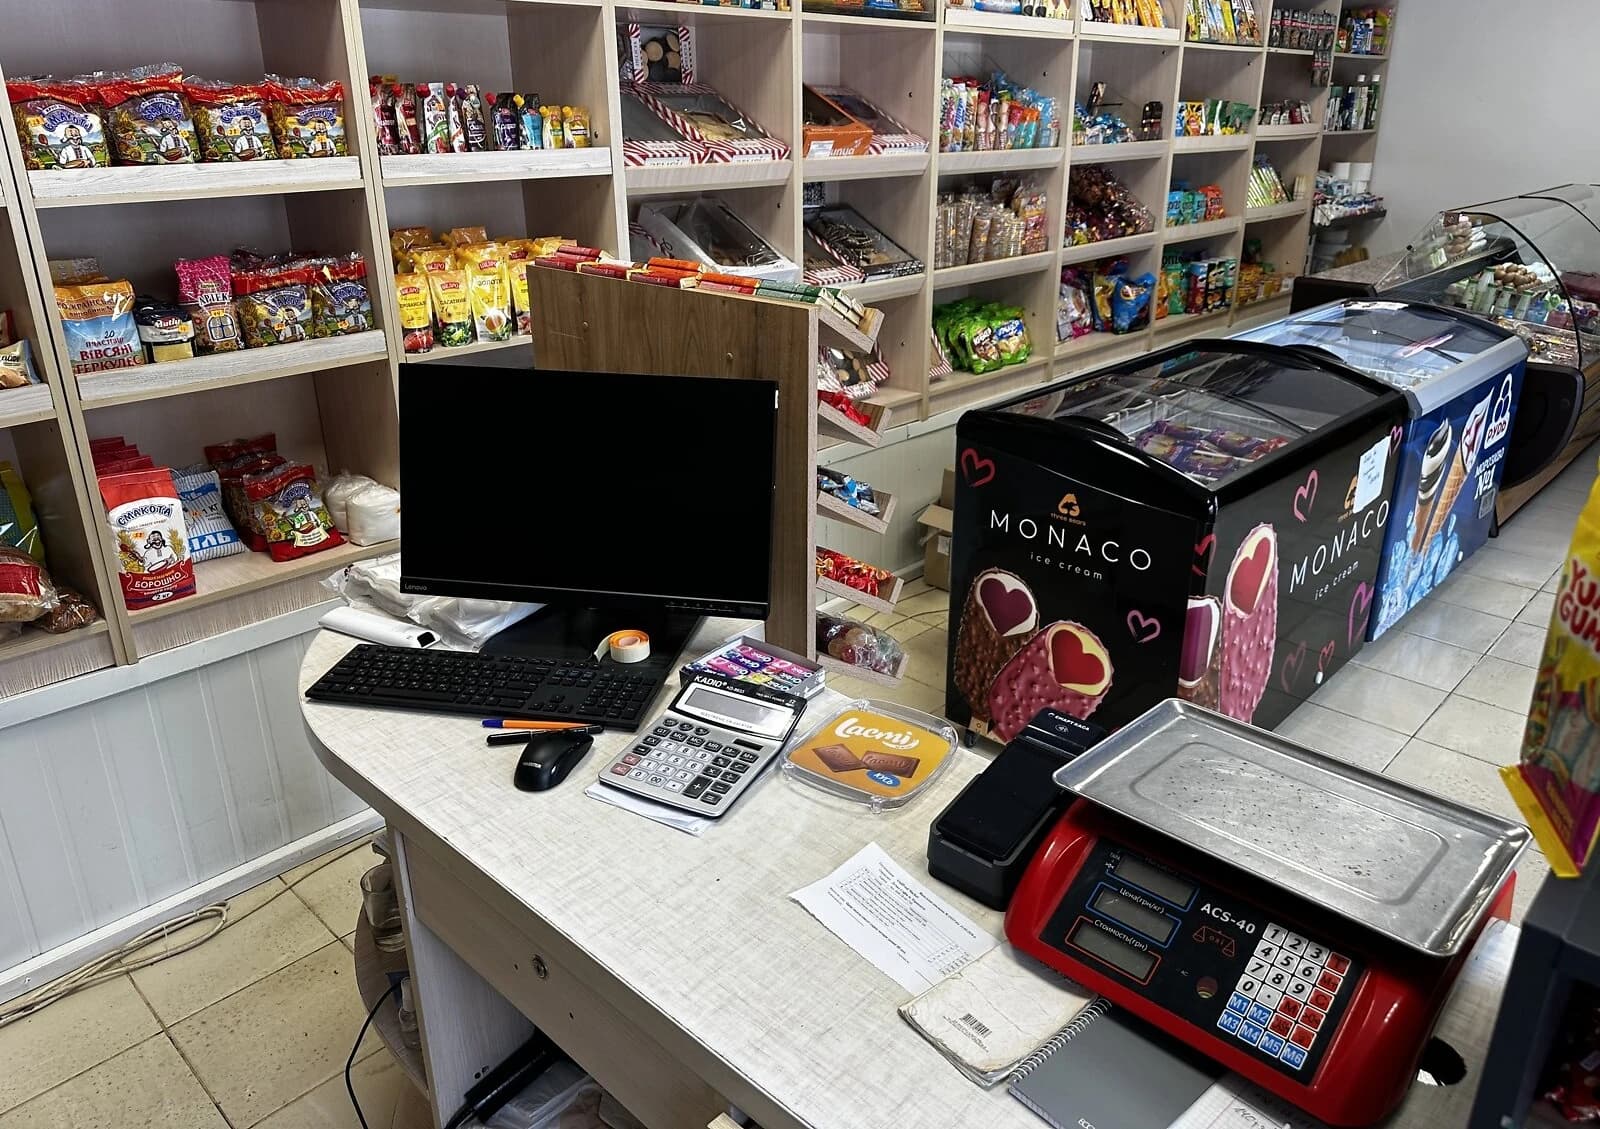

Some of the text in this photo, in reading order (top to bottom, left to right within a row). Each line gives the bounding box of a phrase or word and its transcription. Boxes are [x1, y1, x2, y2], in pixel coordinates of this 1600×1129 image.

[117, 503, 174, 527] СМАКОТА
[188, 532, 232, 549] ІЛЬ
[990, 509, 1151, 571] MONACO
[1289, 500, 1390, 593] MONACO
[135, 572, 182, 589] БОРОШНО
[1030, 551, 1103, 581] ice cream
[1315, 561, 1359, 600] ice cream
[404, 582, 428, 592] Lenovo
[694, 674, 722, 688] KADIO
[691, 737, 702, 745] MC
[834, 717, 914, 746] Lacmi
[1201, 903, 1256, 935] ACS-40
[1094, 919, 1149, 952] Стоимость(грн)
[1272, 929, 1280, 940] 1
[1289, 938, 1301, 950] 2
[1310, 950, 1323, 960] 3
[1261, 946, 1314, 977] 4 5 6
[1243, 981, 1255, 992] 0
[1252, 962, 1264, 973] 7
[1272, 974, 1284, 985] 8
[1295, 983, 1306, 995] 9
[1230, 996, 1269, 1023] M1 M2
[1220, 1014, 1303, 1064] M3 M4 M5 M6
